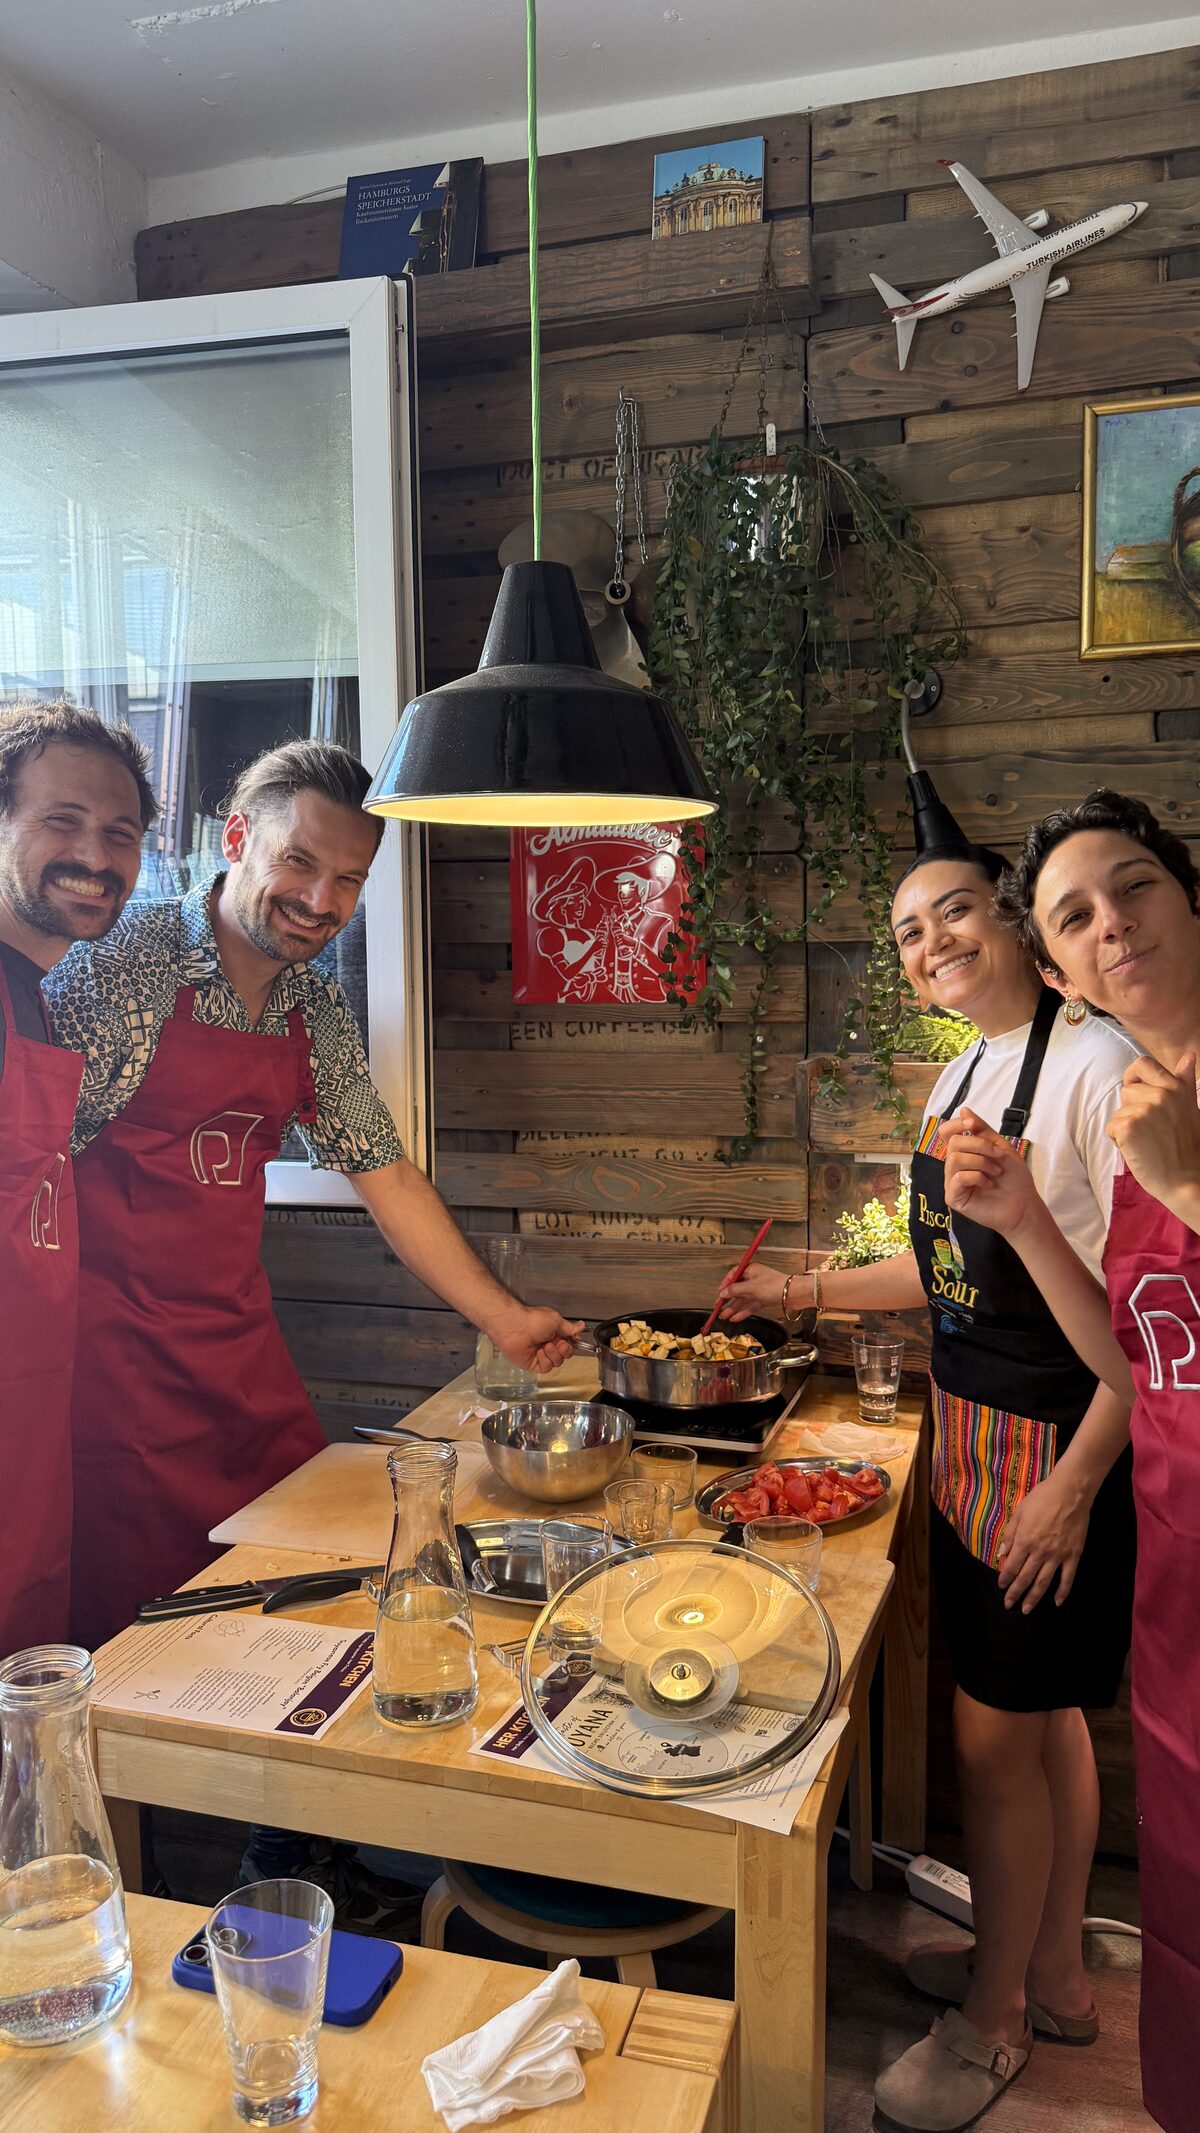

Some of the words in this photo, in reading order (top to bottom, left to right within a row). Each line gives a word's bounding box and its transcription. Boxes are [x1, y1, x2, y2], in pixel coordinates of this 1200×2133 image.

[357, 192, 432, 211] SPEICHERSTADT
[358, 185, 411, 200] HAMBURGS
[1026, 247, 1065, 269] TURKISH
[1066, 227, 1106, 252] AIRLINES
[535, 1211, 573, 1230] LOT
[932, 1265, 980, 1308] Sour
[339, 1650, 374, 1687] KITCHEN
[492, 1731, 517, 1749] HER
[567, 1709, 614, 1747] UYANA
